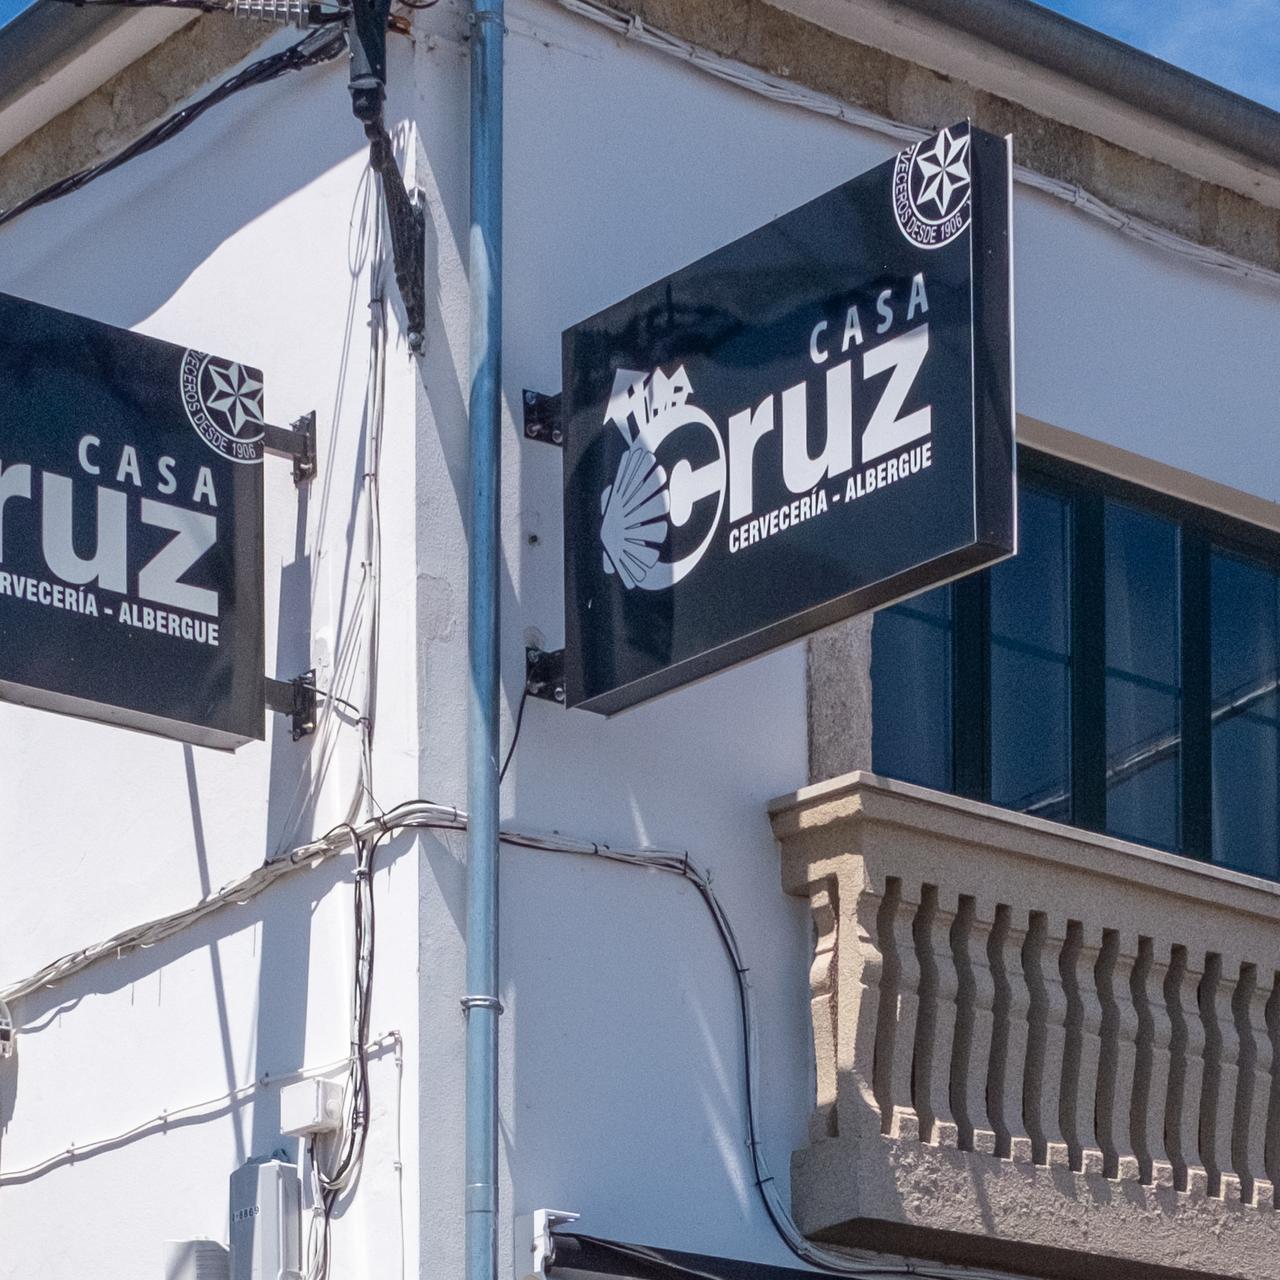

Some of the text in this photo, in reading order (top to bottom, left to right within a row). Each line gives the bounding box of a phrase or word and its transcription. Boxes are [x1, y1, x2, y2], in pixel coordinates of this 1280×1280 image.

[906, 217, 937, 243] DESDE
[941, 212, 963, 240] 1906
[810, 273, 930, 365] CASA
[78, 435, 218, 507] CASA
[194, 413, 228, 452] DESDE
[231, 442, 256, 459] 1906
[601, 322, 932, 590] Cruz
[729, 487, 828, 554] CERVECERÍA
[845, 442, 932, 503] ALBERGUE
[119, 602, 220, 647] ALBERGUE
